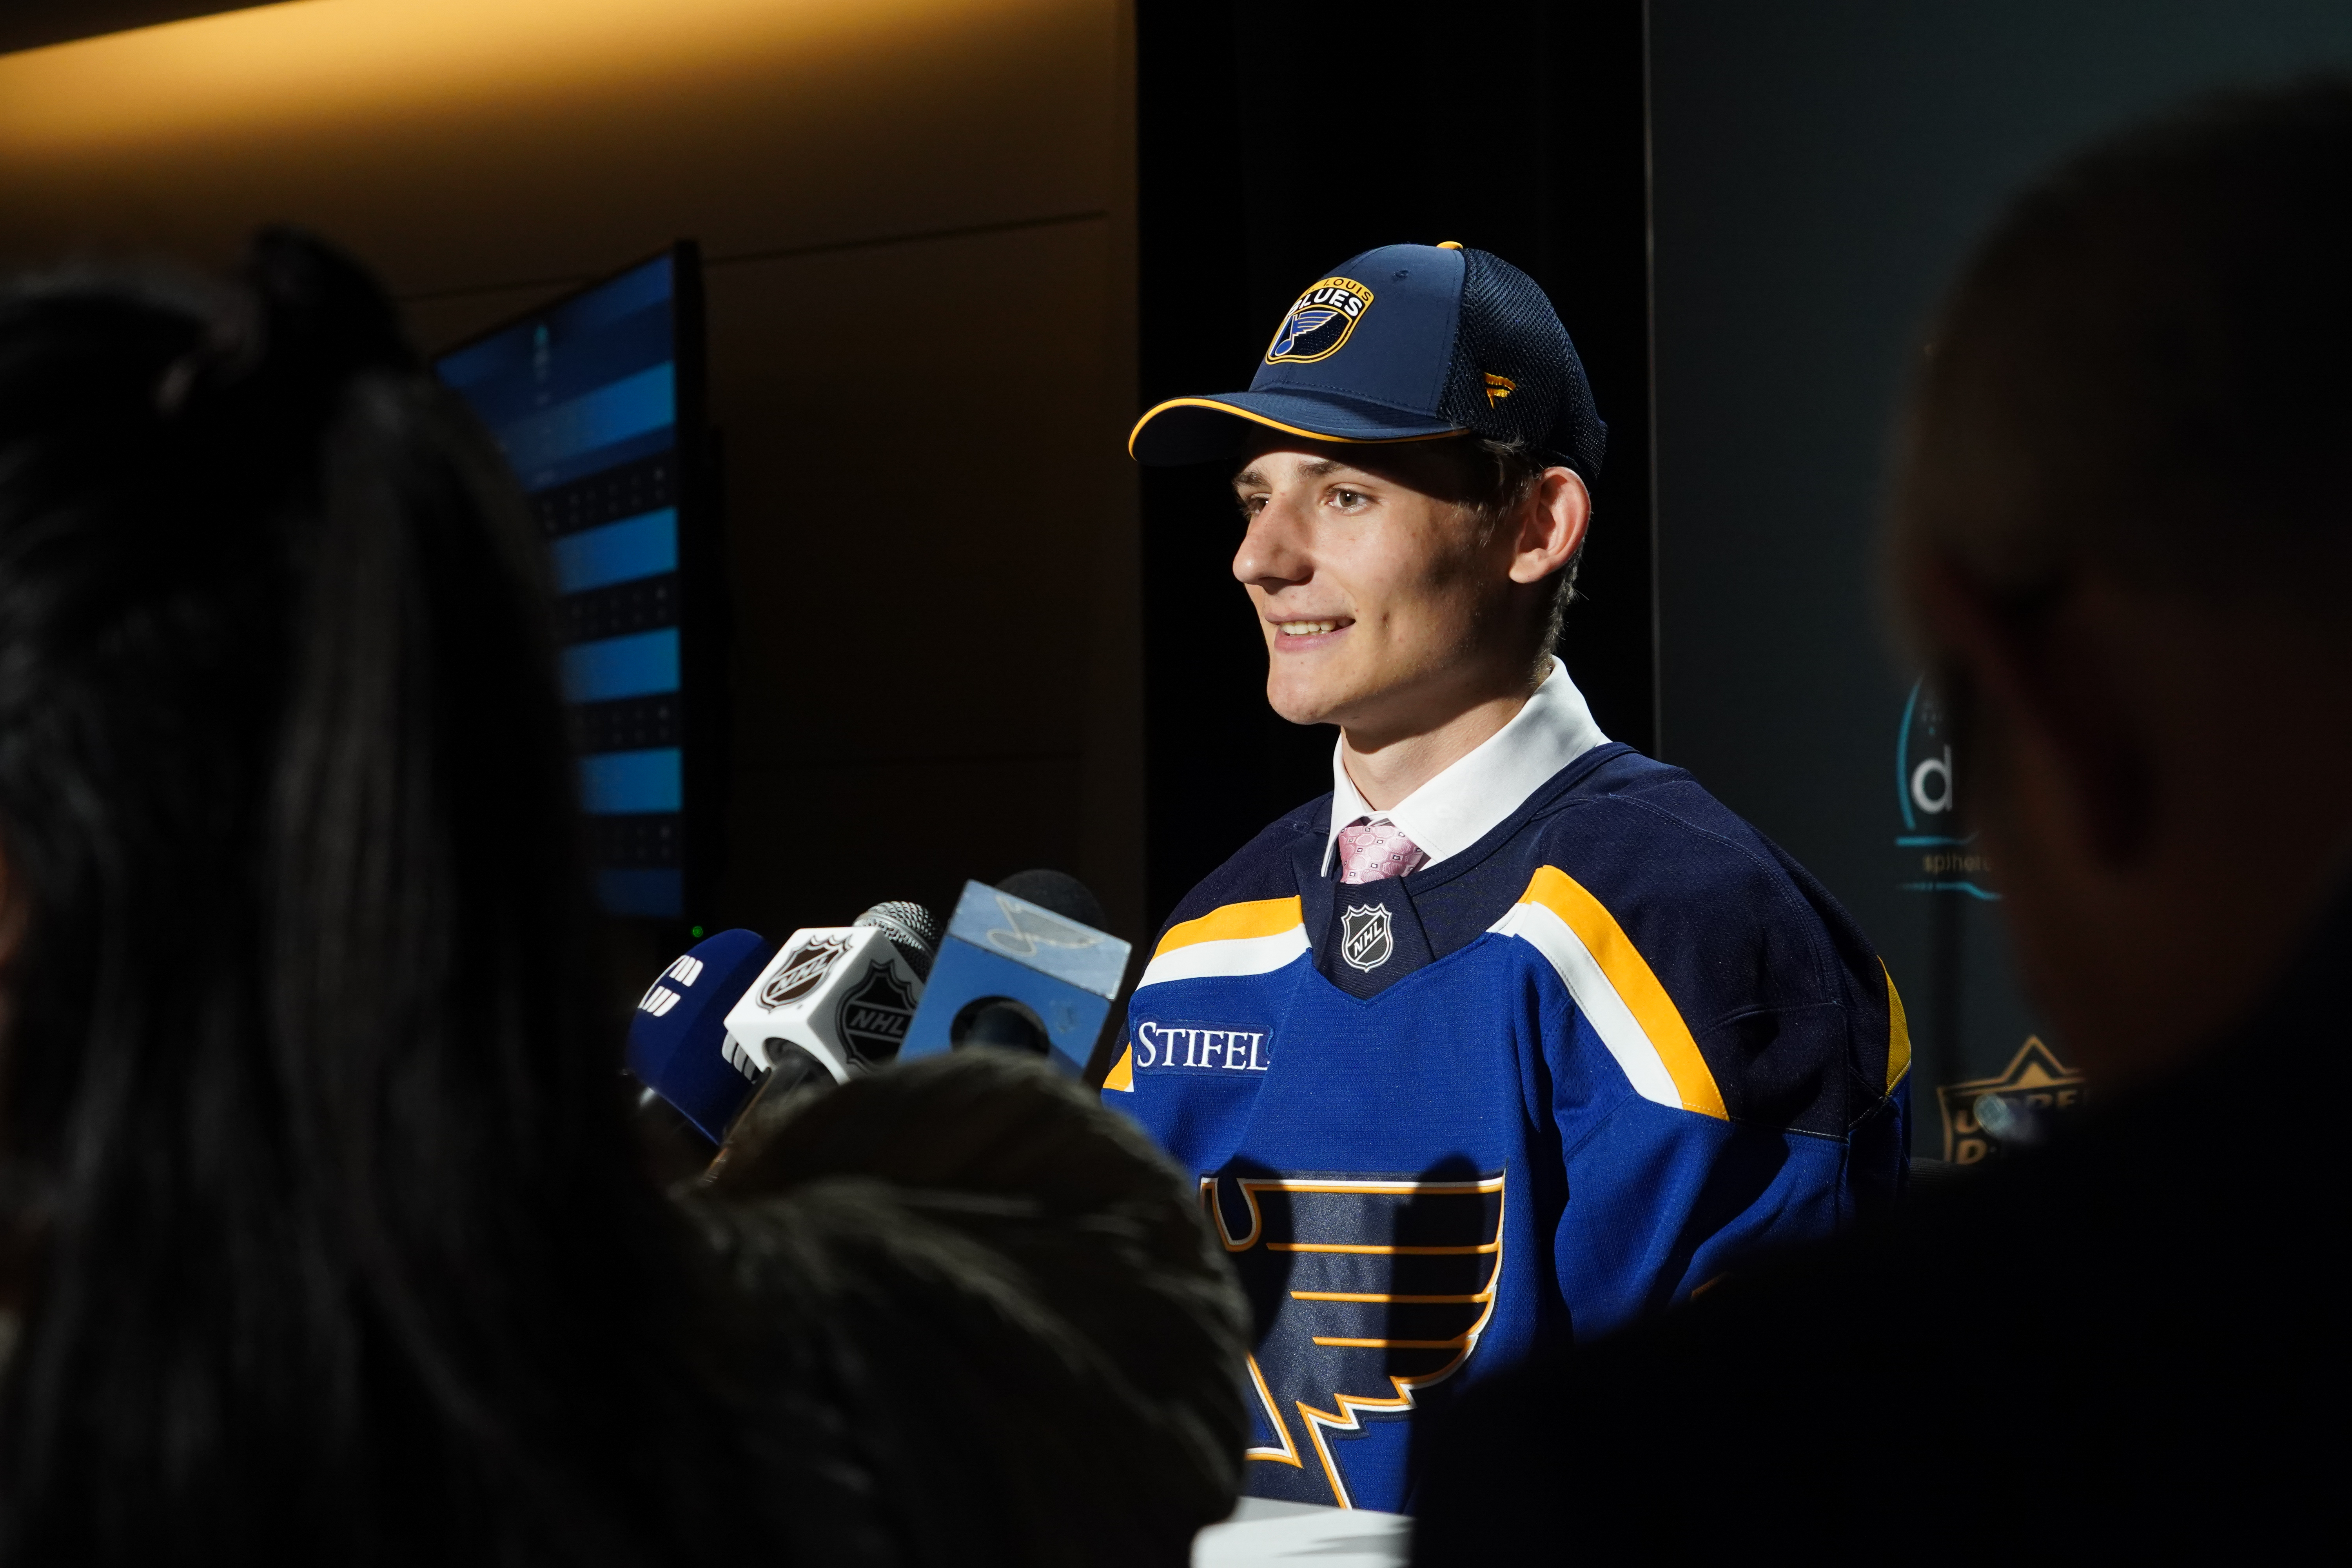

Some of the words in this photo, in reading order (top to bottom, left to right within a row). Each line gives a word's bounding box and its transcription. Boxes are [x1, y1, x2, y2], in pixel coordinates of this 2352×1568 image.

[1323, 278, 1371, 301] LOUIS
[1354, 921, 1382, 957] NHL
[769, 956, 828, 995] NHL
[849, 1009, 904, 1035] NHL
[1137, 1022, 1270, 1071] STIFEL
